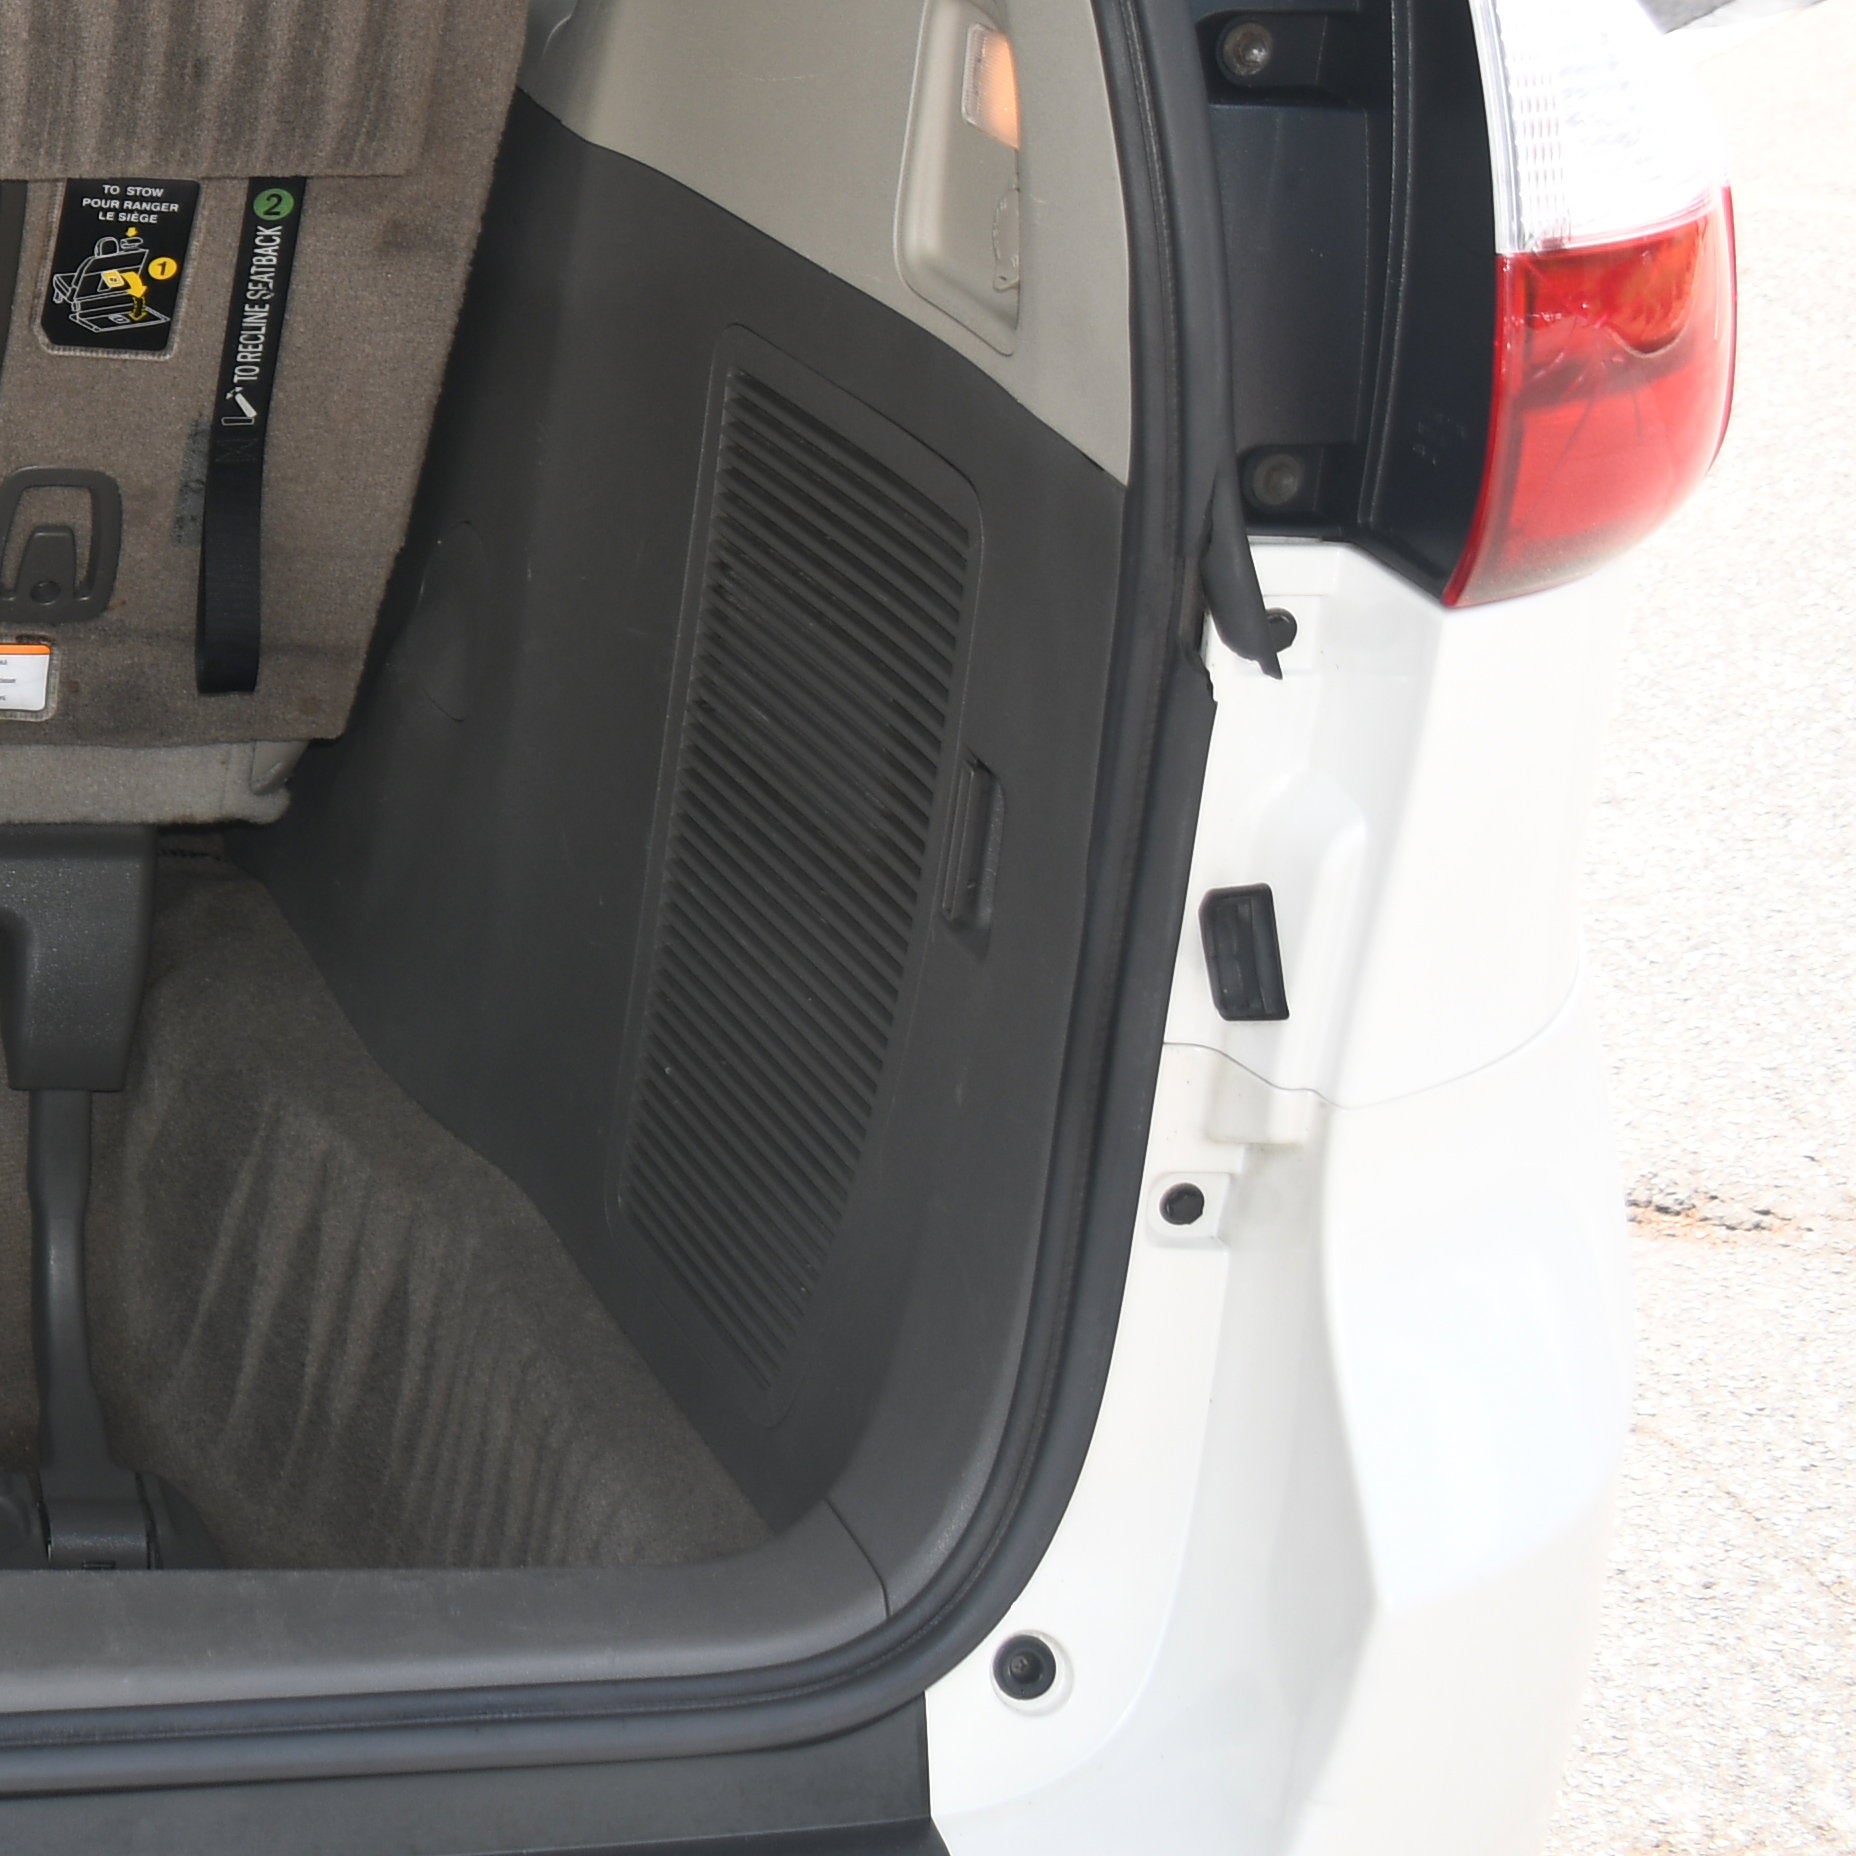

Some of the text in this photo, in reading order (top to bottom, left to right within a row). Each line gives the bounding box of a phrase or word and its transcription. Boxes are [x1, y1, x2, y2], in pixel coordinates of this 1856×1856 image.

[102, 184, 164, 197] TO STOW
[82, 198, 179, 213] POUR RANGER
[262, 193, 283, 216] 2
[98, 211, 158, 224] LE SIÈGE
[157, 261, 168, 276] 1
[233, 224, 283, 384] TO RECLINE SEATBACK
